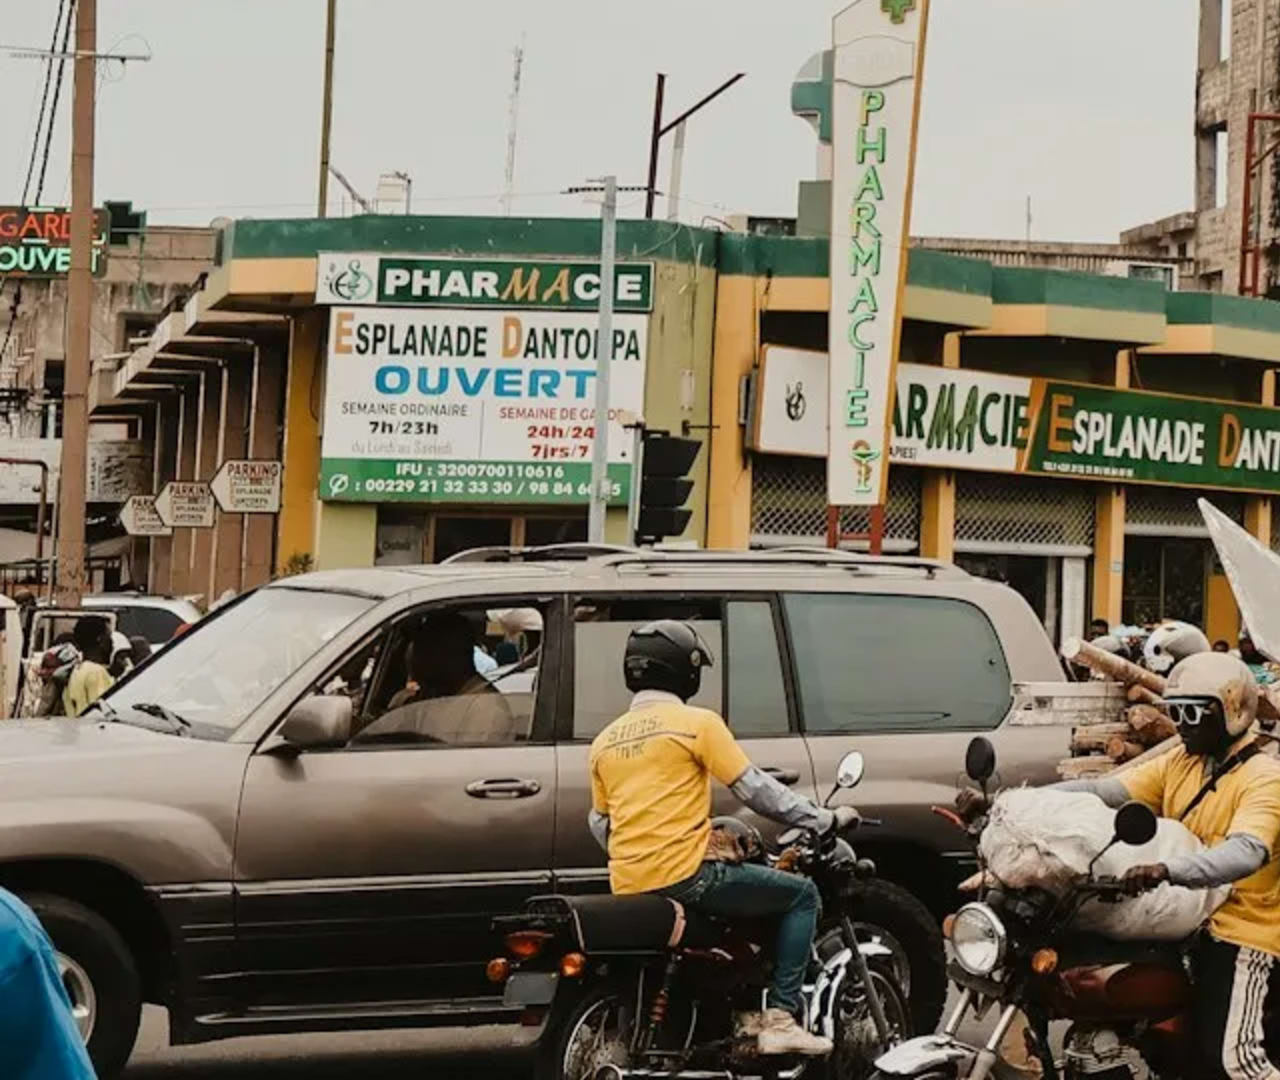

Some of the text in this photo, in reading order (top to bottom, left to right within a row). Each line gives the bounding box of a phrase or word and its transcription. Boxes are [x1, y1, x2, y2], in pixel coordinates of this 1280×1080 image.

[0, 211, 98, 239] GAR
[0, 245, 101, 273] OUVET
[846, 90, 886, 427] PHARMACIE
[384, 267, 643, 302] PHARMACE
[501, 316, 640, 361] DANTOPA
[374, 365, 598, 398] OUVERT
[342, 402, 469, 418] SEMAINE ORDINAIRE
[499, 406, 558, 421] SEMAINE
[560, 407, 577, 421] DE
[369, 420, 439, 435] 7h/23h
[1047, 393, 1205, 465] ESPLANADE
[531, 444, 588, 459] 7jrs/7
[227, 463, 279, 478] PARKING
[395, 463, 423, 476] IFU
[365, 479, 415, 494] 00229
[418, 479, 438, 494] 21
[443, 480, 464, 494] 32
[468, 480, 489, 495] 33
[492, 480, 513, 495] 30
[529, 481, 549, 496] 98
[553, 482, 573, 496] 84
